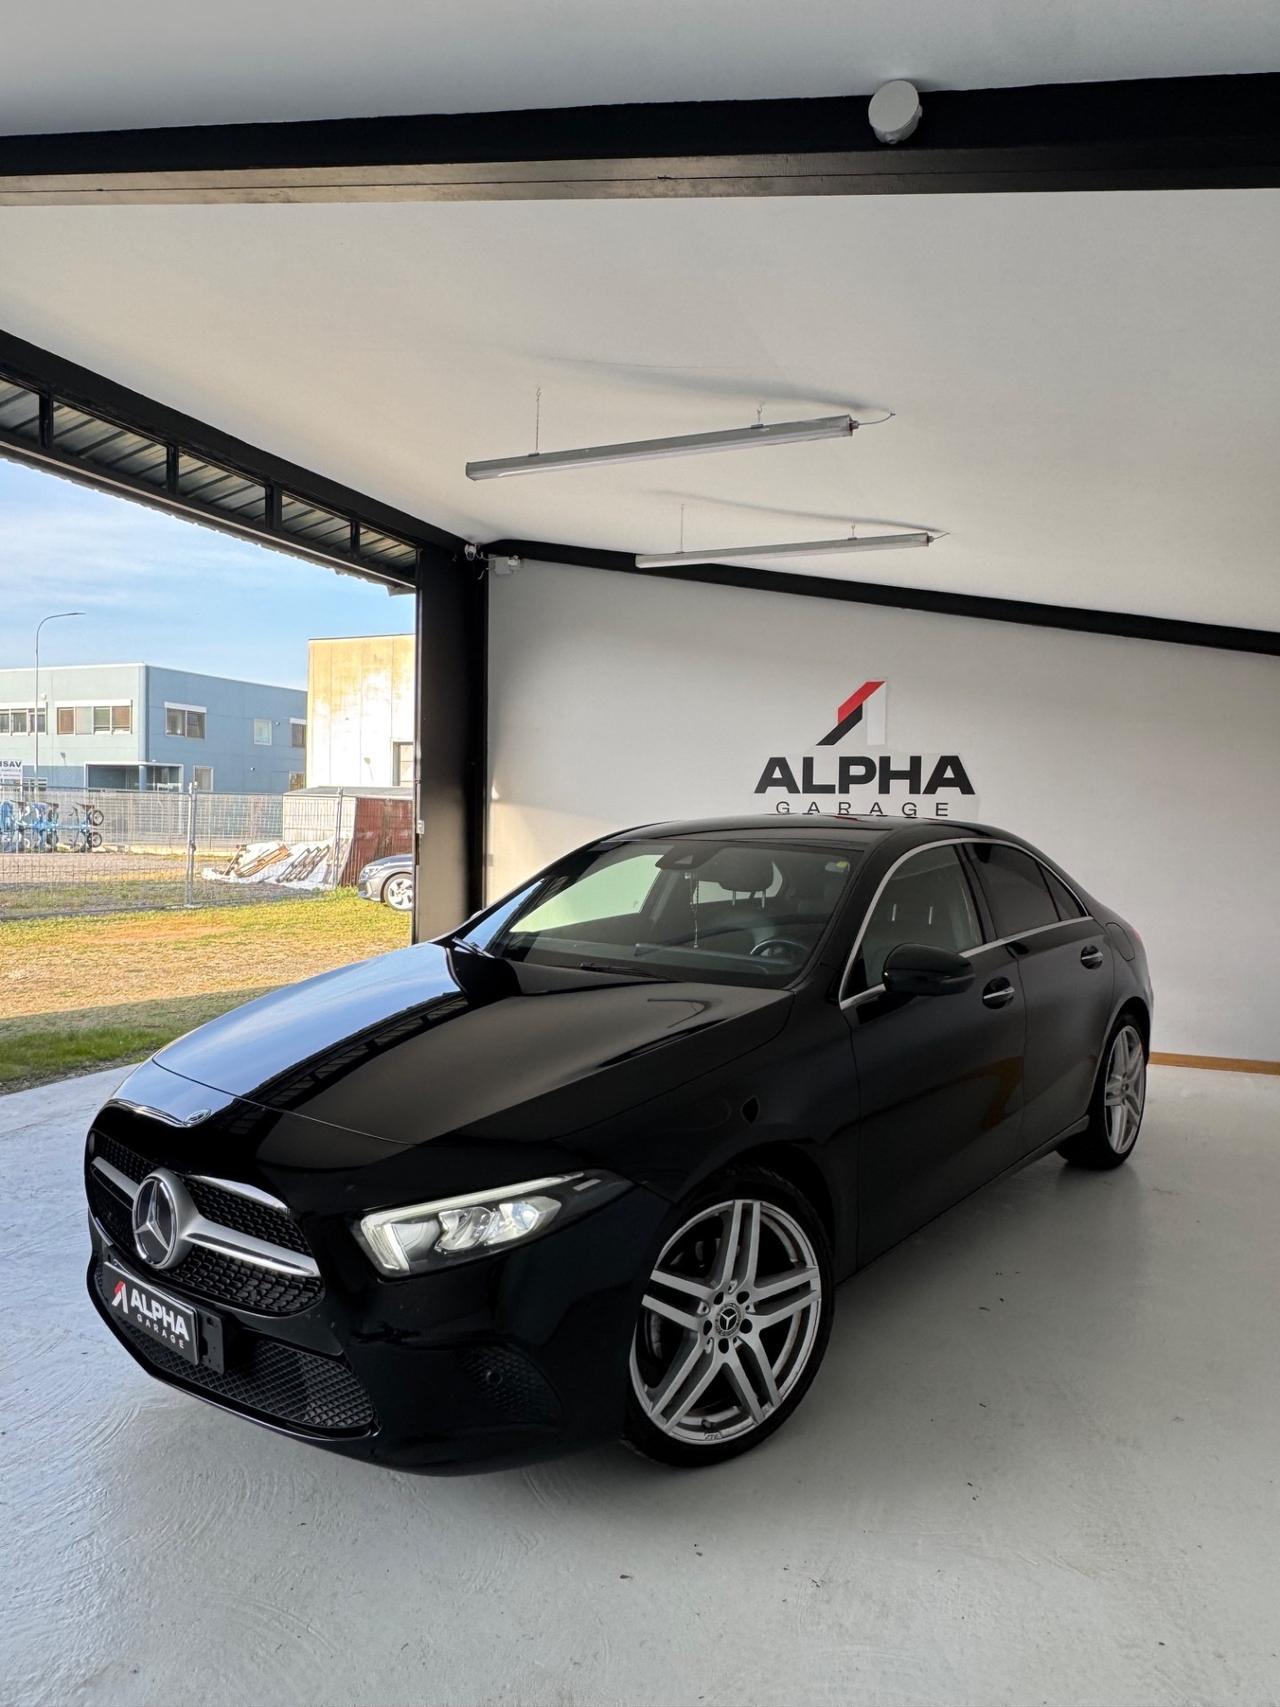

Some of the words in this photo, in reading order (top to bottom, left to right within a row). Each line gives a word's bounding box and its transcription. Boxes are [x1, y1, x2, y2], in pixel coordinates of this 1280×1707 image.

[754, 756, 975, 795] ALPHA
[776, 801, 949, 817] GARAGE
[131, 1289, 190, 1341] ALPHA
[137, 1314, 185, 1349] GARAGE
